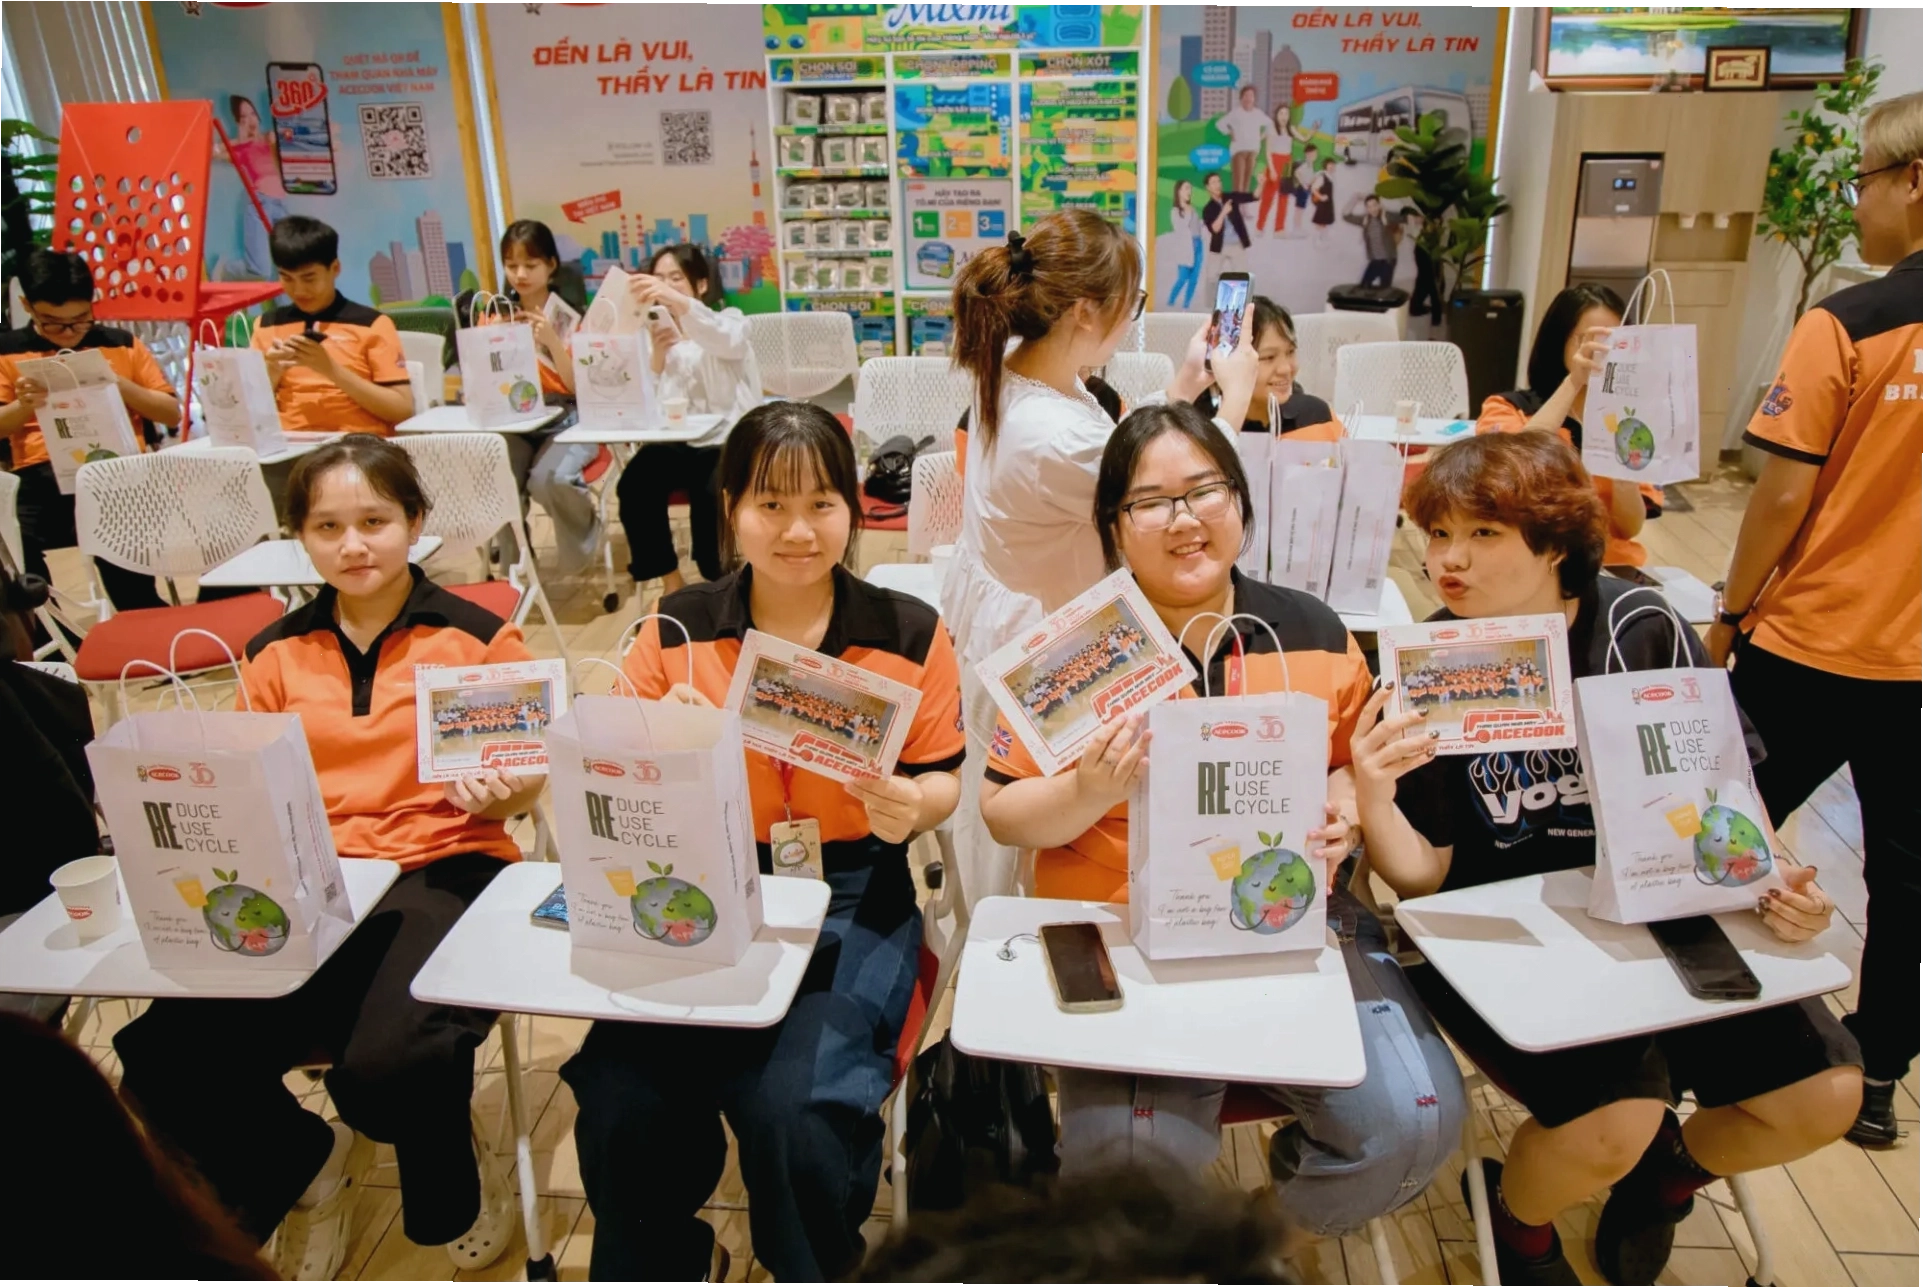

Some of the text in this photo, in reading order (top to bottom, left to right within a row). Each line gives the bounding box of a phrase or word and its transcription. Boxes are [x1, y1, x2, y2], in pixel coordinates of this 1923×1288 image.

[1344, 7, 1373, 28] LÀ
[1340, 27, 1480, 53] THẤY LÀ TIN
[533, 37, 693, 66] ĐẾN LÀ VUI,
[597, 65, 766, 95] THẤY LÀ TIN
[914, 216, 923, 232] 1
[979, 216, 990, 231] 3
[1884, 384, 1923, 401] BR
[1124, 663, 1183, 710] ACECOOK
[1492, 725, 1565, 740] ACECOOK
[1670, 719, 1711, 736] DUCE
[1636, 722, 1677, 776] RE
[1674, 738, 1706, 754] USE
[503, 755, 549, 767] ACECO
[1235, 760, 1283, 776] DUCE
[1679, 755, 1721, 773] CYCLE
[1198, 761, 1231, 815] RE
[1235, 780, 1270, 796] USE
[176, 802, 222, 818] DUCE
[616, 797, 666, 815] DUCE
[1234, 798, 1291, 815] CYCLE
[585, 790, 619, 842] RE
[619, 815, 654, 831] USE
[142, 801, 183, 850] RE
[179, 820, 214, 836] USE
[1547, 828, 1566, 837] NEW
[185, 838, 240, 854] CYCLE
[621, 832, 679, 848] CYCLE
